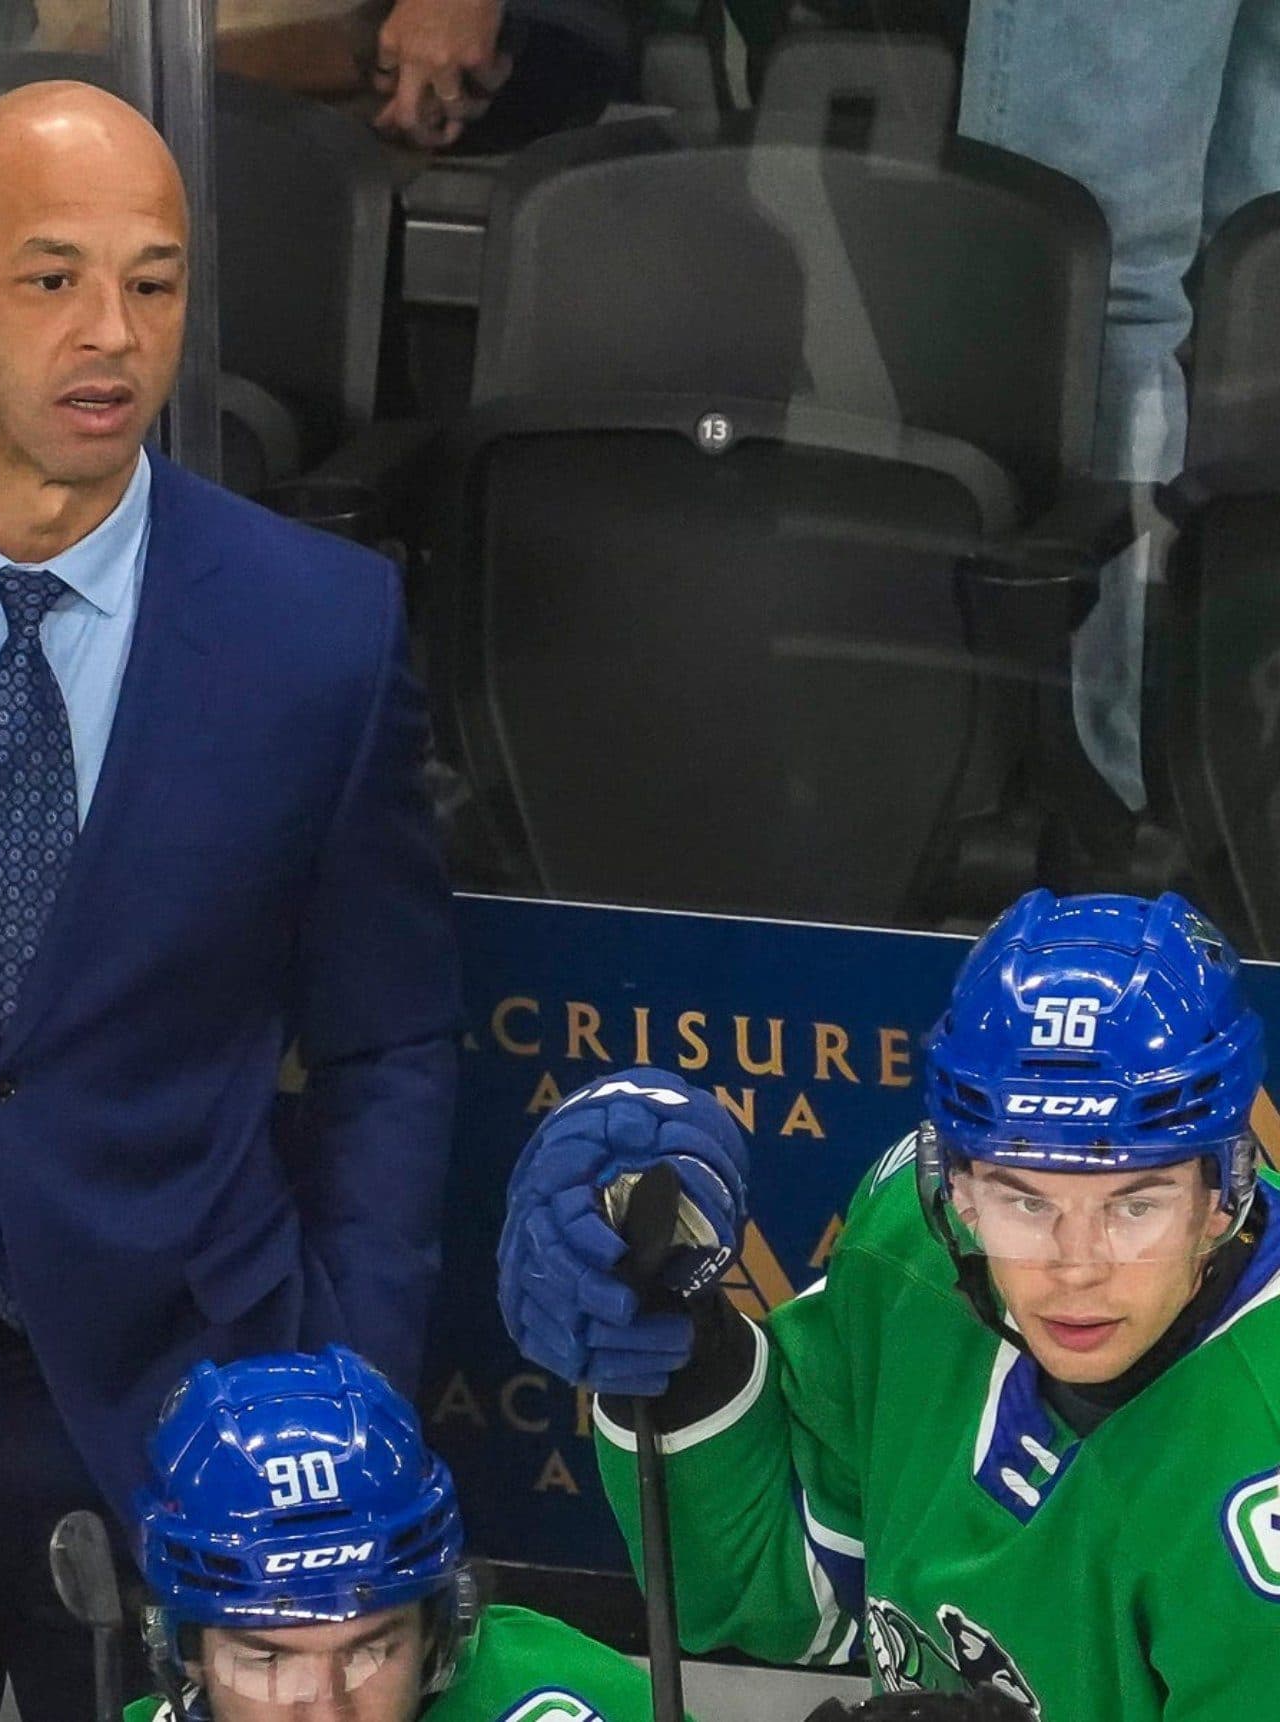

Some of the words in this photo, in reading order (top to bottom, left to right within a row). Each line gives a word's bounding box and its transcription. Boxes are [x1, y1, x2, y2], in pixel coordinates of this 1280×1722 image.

[703, 420, 726, 440] 13
[463, 997, 912, 1087] CRISURE
[1031, 997, 1100, 1047] 56
[527, 1071, 826, 1138] ANA
[1006, 1094, 1118, 1116] CCM
[265, 1450, 339, 1507] 90
[265, 1541, 375, 1573] CCM
